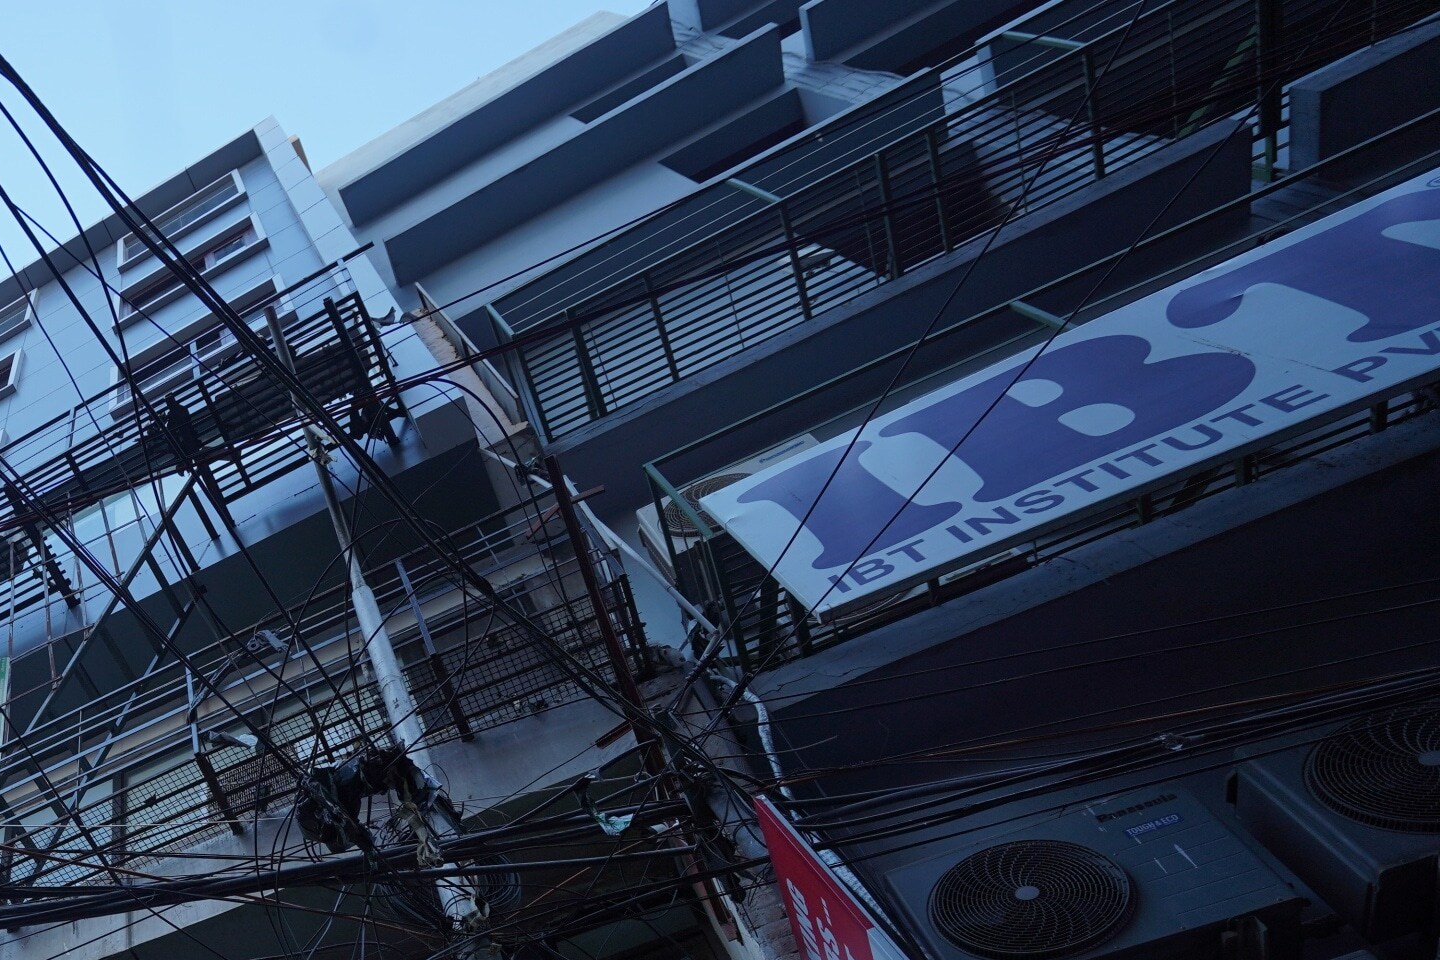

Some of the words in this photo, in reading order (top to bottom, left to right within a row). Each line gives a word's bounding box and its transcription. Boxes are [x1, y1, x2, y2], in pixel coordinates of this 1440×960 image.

[827, 540, 929, 594] IBT
[946, 384, 1332, 544] INSTITUTE
[1125, 822, 1156, 838] TOUGH
[1161, 813, 1180, 826] ECO
